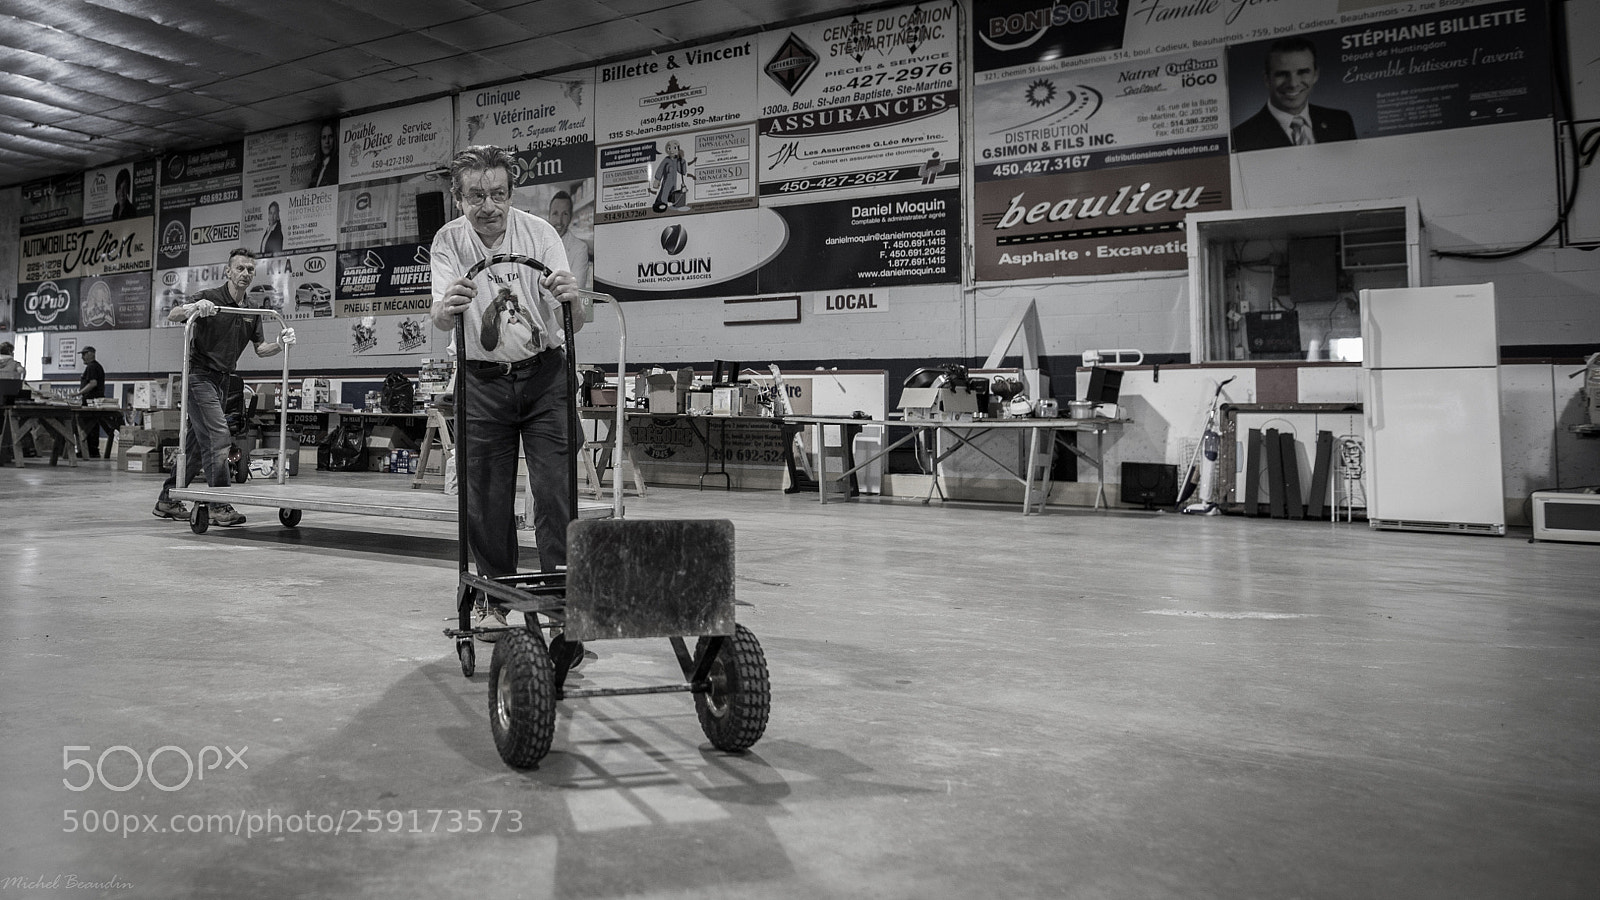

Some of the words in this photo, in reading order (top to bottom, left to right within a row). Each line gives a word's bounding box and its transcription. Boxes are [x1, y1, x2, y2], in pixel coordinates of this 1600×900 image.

[823, 20, 873, 42] CENTRE
[876, 16, 895, 33] DU
[898, 8, 952, 29] CAMION
[1341, 22, 1436, 50] STÉPHANE
[1440, 8, 1527, 34] BILLETTE
[1001, 68, 1027, 78] chemin
[1192, 33, 1243, 48] Beauharnois
[1298, 16, 1337, 30] Cadieux,
[1341, 6, 1399, 23] Beauharnois
[1341, 50, 1374, 63] Député
[1376, 47, 1387, 57] de
[1390, 39, 1447, 56] Huntingdon
[602, 61, 659, 83] Billette
[666, 54, 681, 70] &
[686, 41, 751, 66] Vincent
[890, 52, 950, 67] SERVICE
[822, 61, 953, 94] 450-427-2976
[1117, 66, 1160, 83] Natrel
[1342, 58, 1406, 84] Ensemble
[1408, 55, 1468, 75] bâtissons
[476, 89, 521, 107] Clinique
[643, 95, 669, 104] PRODUITS
[817, 94, 851, 107] St-Jean
[853, 89, 893, 105] Baptiste,
[896, 78, 953, 94] Ste-Martine
[493, 104, 556, 126] Vétérinaire
[769, 93, 947, 134] ASSURANCES
[343, 122, 377, 144] Double
[402, 121, 432, 135] Service
[608, 131, 624, 139] 1315
[692, 112, 741, 126] Ste-Martine
[1005, 123, 1089, 144] DISTRIBUTION
[363, 133, 393, 151] Délice
[397, 136, 406, 146] de
[408, 131, 438, 144] traiteur
[526, 133, 589, 151] 450-825-9000
[821, 142, 871, 155] Assurances
[901, 135, 924, 145] Myre
[927, 133, 945, 141] Inc.
[982, 142, 1038, 160] G.SIMON
[1041, 140, 1051, 152] &
[1054, 136, 1085, 151] FILS
[1089, 133, 1117, 147] INC.
[812, 158, 838, 166] Cabinet
[849, 153, 884, 162] assurance
[895, 147, 935, 158] dommages
[993, 155, 1091, 177] 450.427.3167
[780, 169, 899, 193] 450-427-2627
[604, 200, 647, 211] Sainte-Martine
[851, 203, 892, 218] Daniel
[896, 198, 946, 214] Moquin
[995, 182, 1205, 230] beaulieu
[888, 214, 927, 223] administrateur
[191, 226, 212, 245] OK
[213, 224, 240, 240] PNEUS
[825, 228, 946, 245] danielmoquin@danielmoquin.ca
[883, 241, 890, 249] T.
[893, 237, 946, 248] 450.691.1415
[23, 232, 78, 258] AUTOMOBILES
[63, 229, 135, 273] Julien
[160, 242, 188, 254] LAPLANTE
[880, 250, 887, 258] F.
[890, 247, 946, 258] 450.691.2042
[998, 248, 1079, 266] Asphalte
[1097, 240, 1188, 258] Excavatio
[308, 260, 322, 271] KIA
[393, 264, 432, 274] MONSIEUR
[637, 257, 712, 278] MOQUIN
[888, 256, 946, 267] 1.877.691.1415
[390, 272, 432, 286] MUFFLE
[858, 266, 946, 279] www.danielmoquin.ca
[29, 294, 65, 310] O'Pub
[343, 303, 370, 313] PNEUS
[372, 302, 382, 311] ET
[383, 299, 432, 311] MÉCANIQU
[826, 293, 878, 311] LOCAL
[651, 450, 669, 459] 1945
